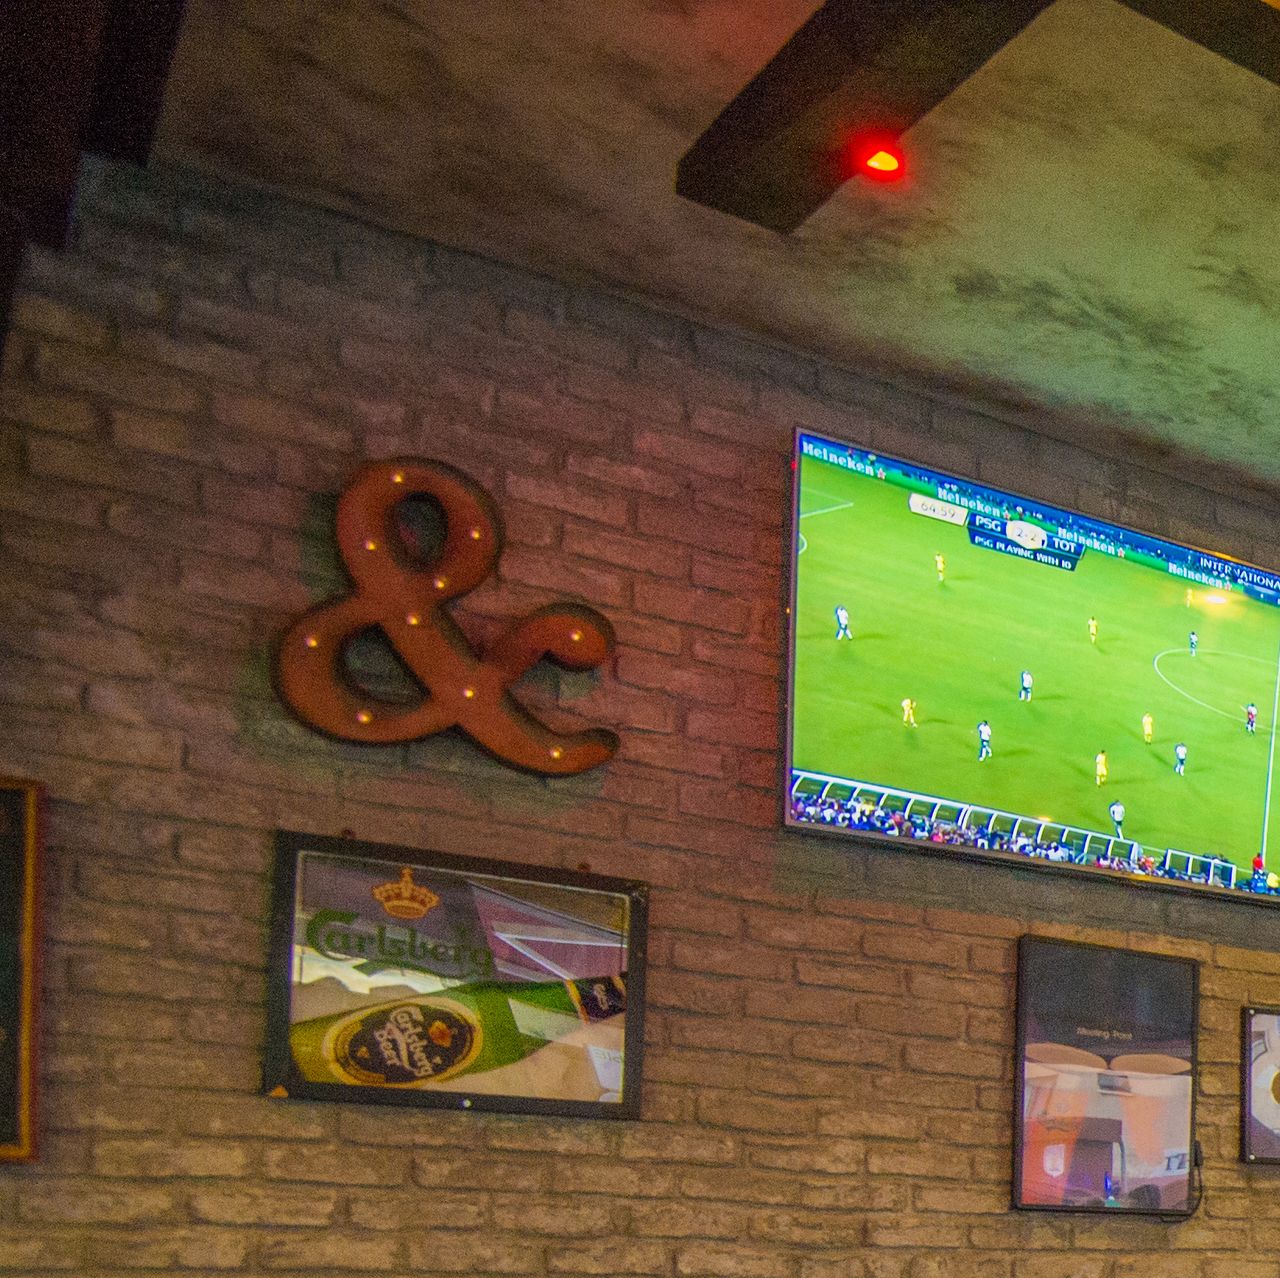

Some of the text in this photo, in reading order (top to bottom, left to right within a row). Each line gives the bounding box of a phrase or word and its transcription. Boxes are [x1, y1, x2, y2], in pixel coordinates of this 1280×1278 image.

[802, 441, 875, 477] Heineken
[937, 487, 1001, 517] Heineken
[974, 535, 994, 548] PSG
[995, 541, 1035, 559] PLAYING
[1036, 552, 1060, 567] WITH
[975, 515, 1002, 533] PSG
[1052, 537, 1078, 554] TOT
[1057, 527, 1116, 556] Heineken
[1168, 562, 1223, 590] Heineken
[305, 908, 493, 979] Carlsberg
[389, 1005, 436, 1078] Carlsberg
